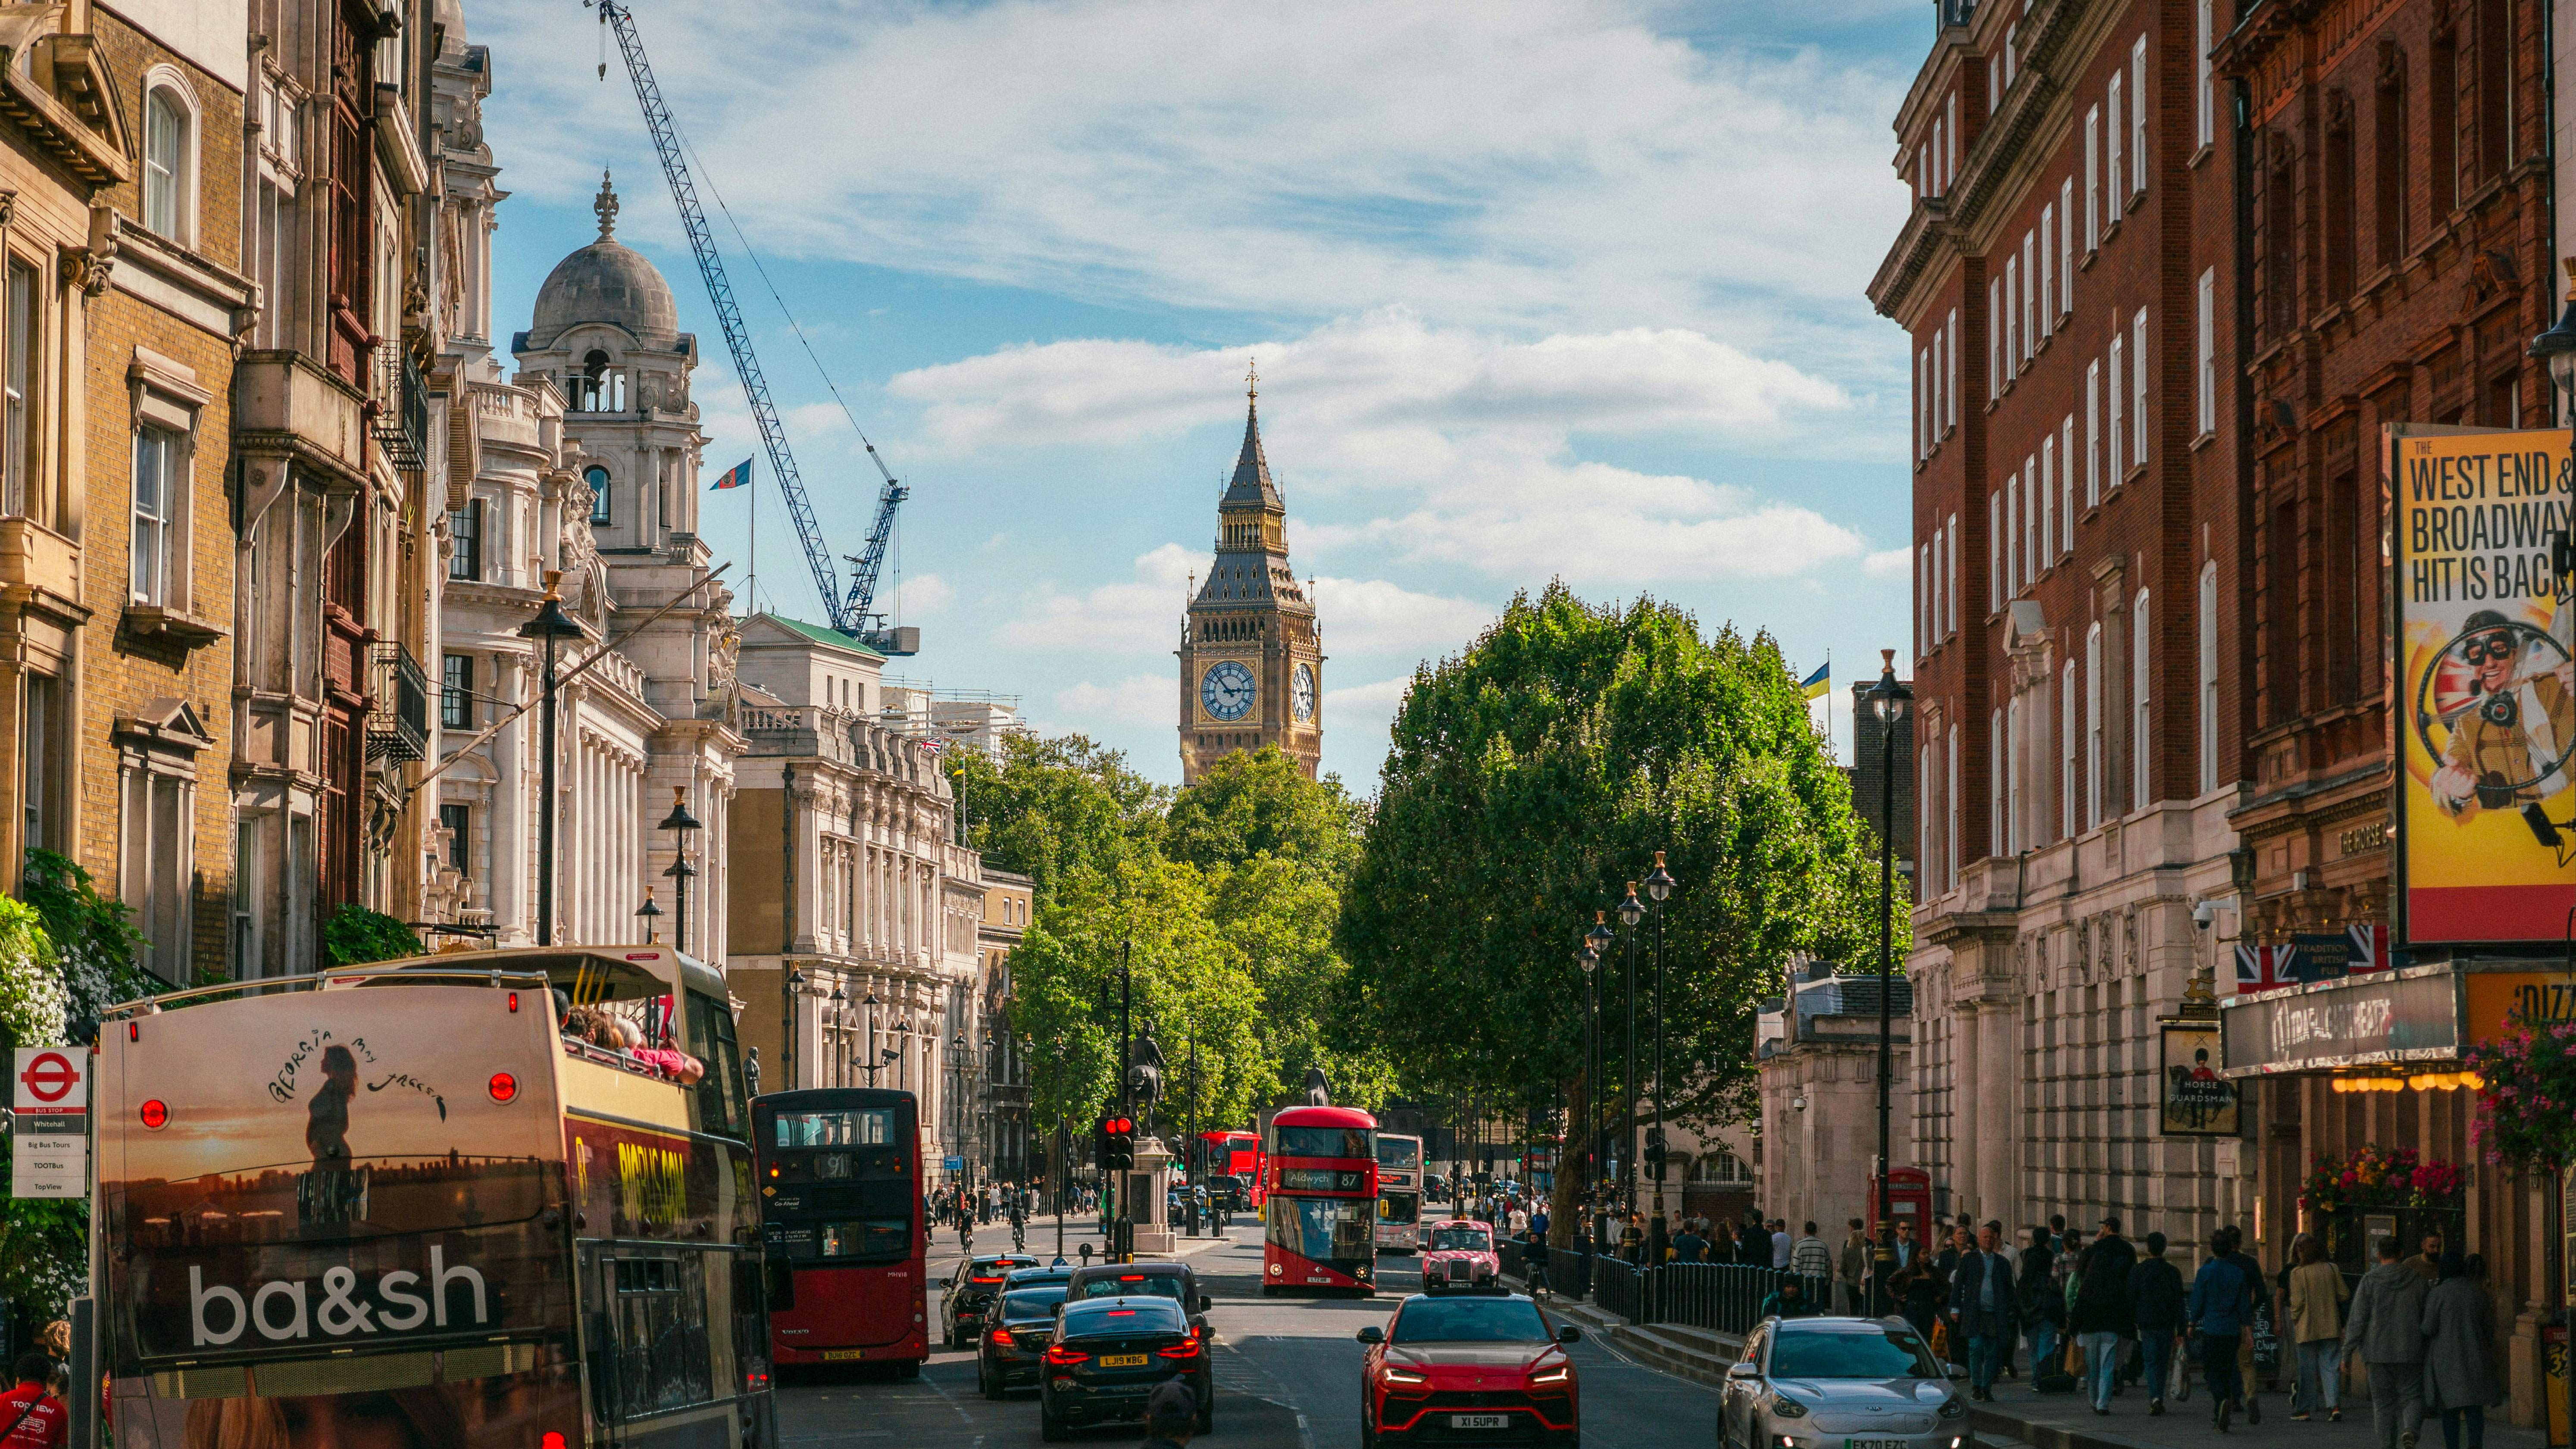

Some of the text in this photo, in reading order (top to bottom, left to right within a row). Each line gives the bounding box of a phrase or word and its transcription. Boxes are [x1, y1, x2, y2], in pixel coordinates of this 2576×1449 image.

[2415, 440, 2432, 455] THE
[2410, 451, 2573, 501] WEST END &
[2411, 500, 2574, 553] BROADWAY
[2413, 557, 2457, 603] HIT
[2461, 556, 2487, 601] IS
[2339, 831, 2353, 854] THE
[2354, 823, 2380, 851] HORSE
[2311, 956, 2348, 964] BRITISH
[2320, 966, 2339, 975] PUB
[2170, 1095, 2232, 1103] GUARDSMAN
[1291, 1173, 1357, 1187] Aldwych 87
[190, 1245, 488, 1346] ba&sh
[1105, 1357, 1124, 1365] LJ19
[11, 1401, 55, 1414] TOPIEW
[1853, 1440, 1882, 1449] EK70
